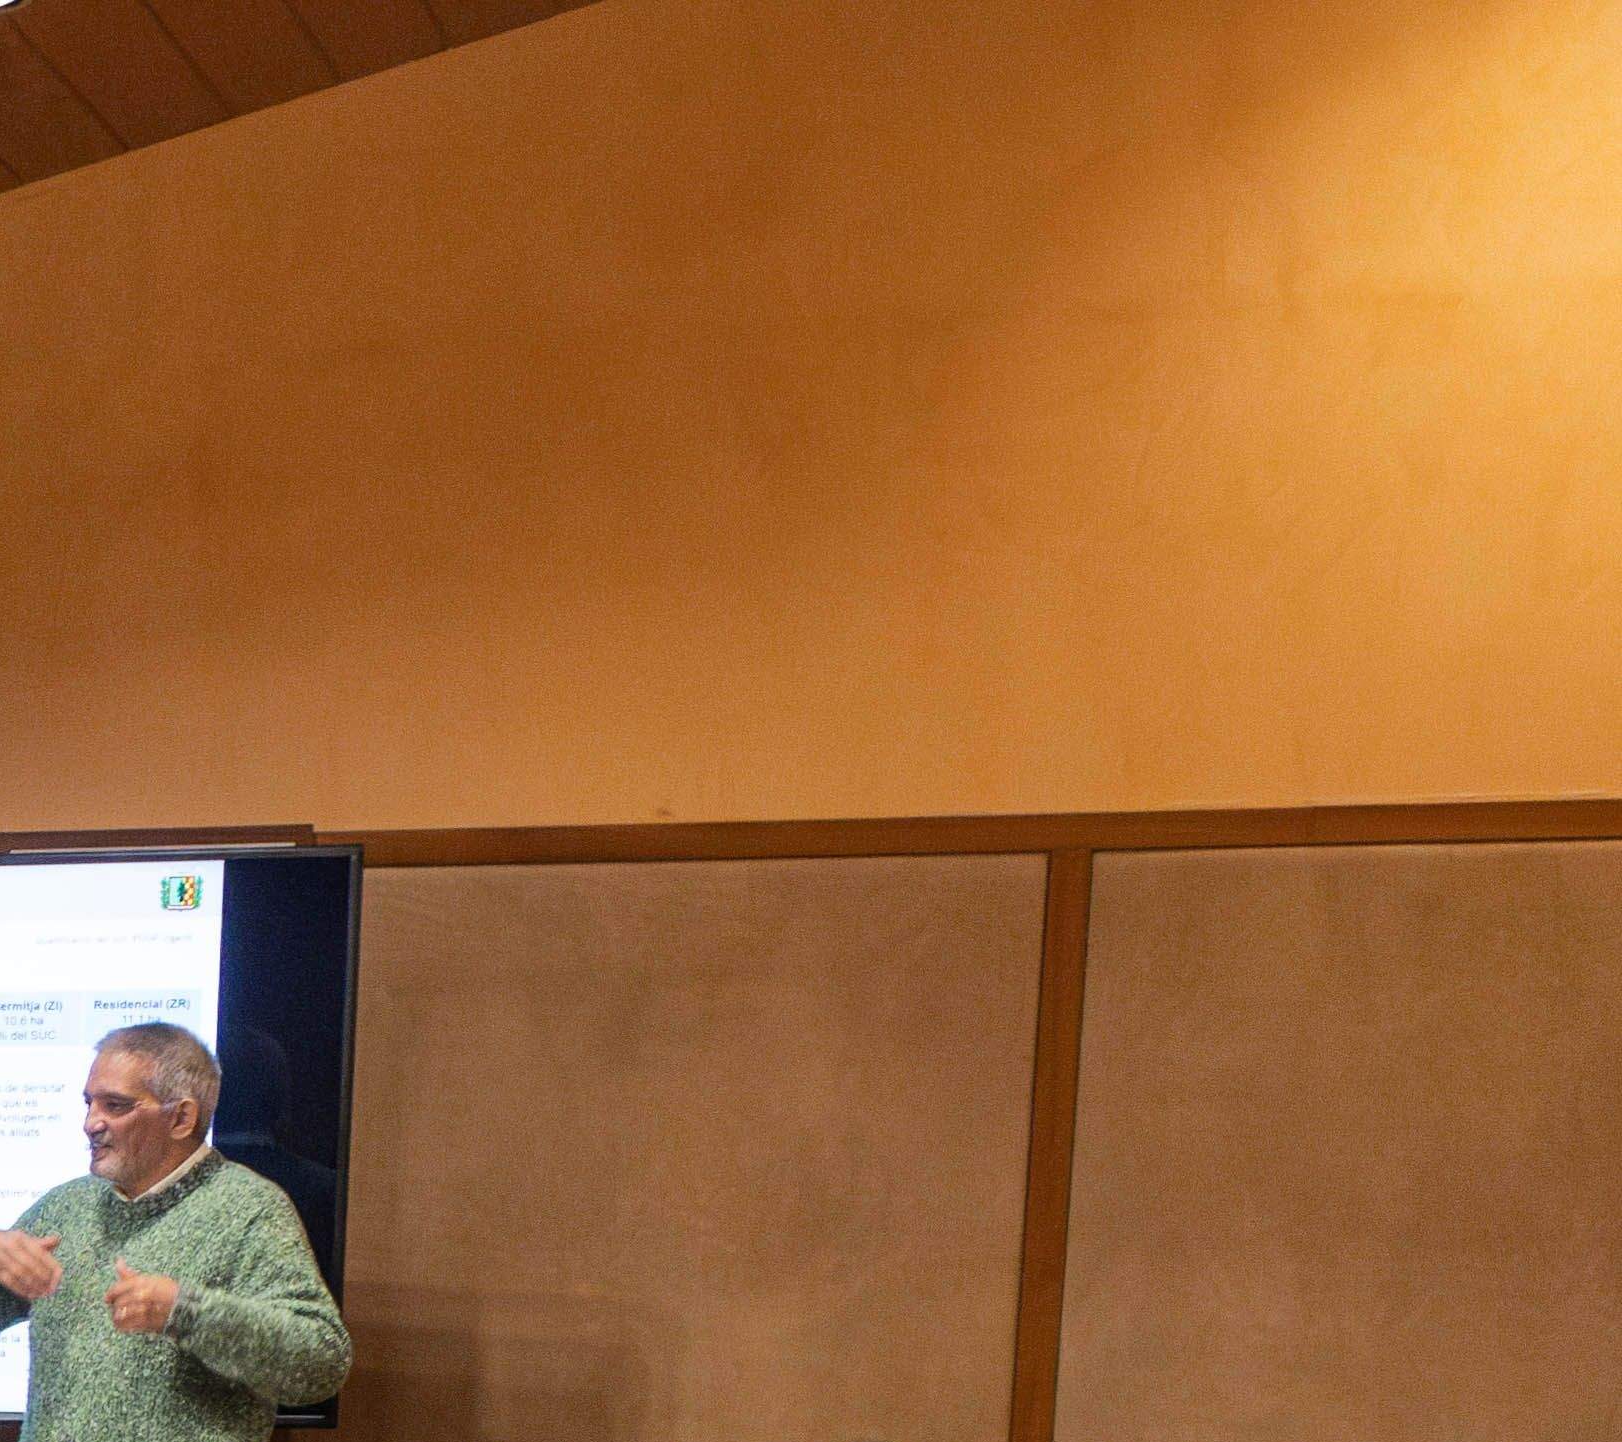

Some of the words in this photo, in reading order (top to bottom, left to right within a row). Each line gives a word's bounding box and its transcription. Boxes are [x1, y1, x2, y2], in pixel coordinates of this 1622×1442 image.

[43, 1000, 63, 1013] (ZI)
[93, 998, 163, 1011] Residencial
[166, 998, 191, 1012] (ZR)
